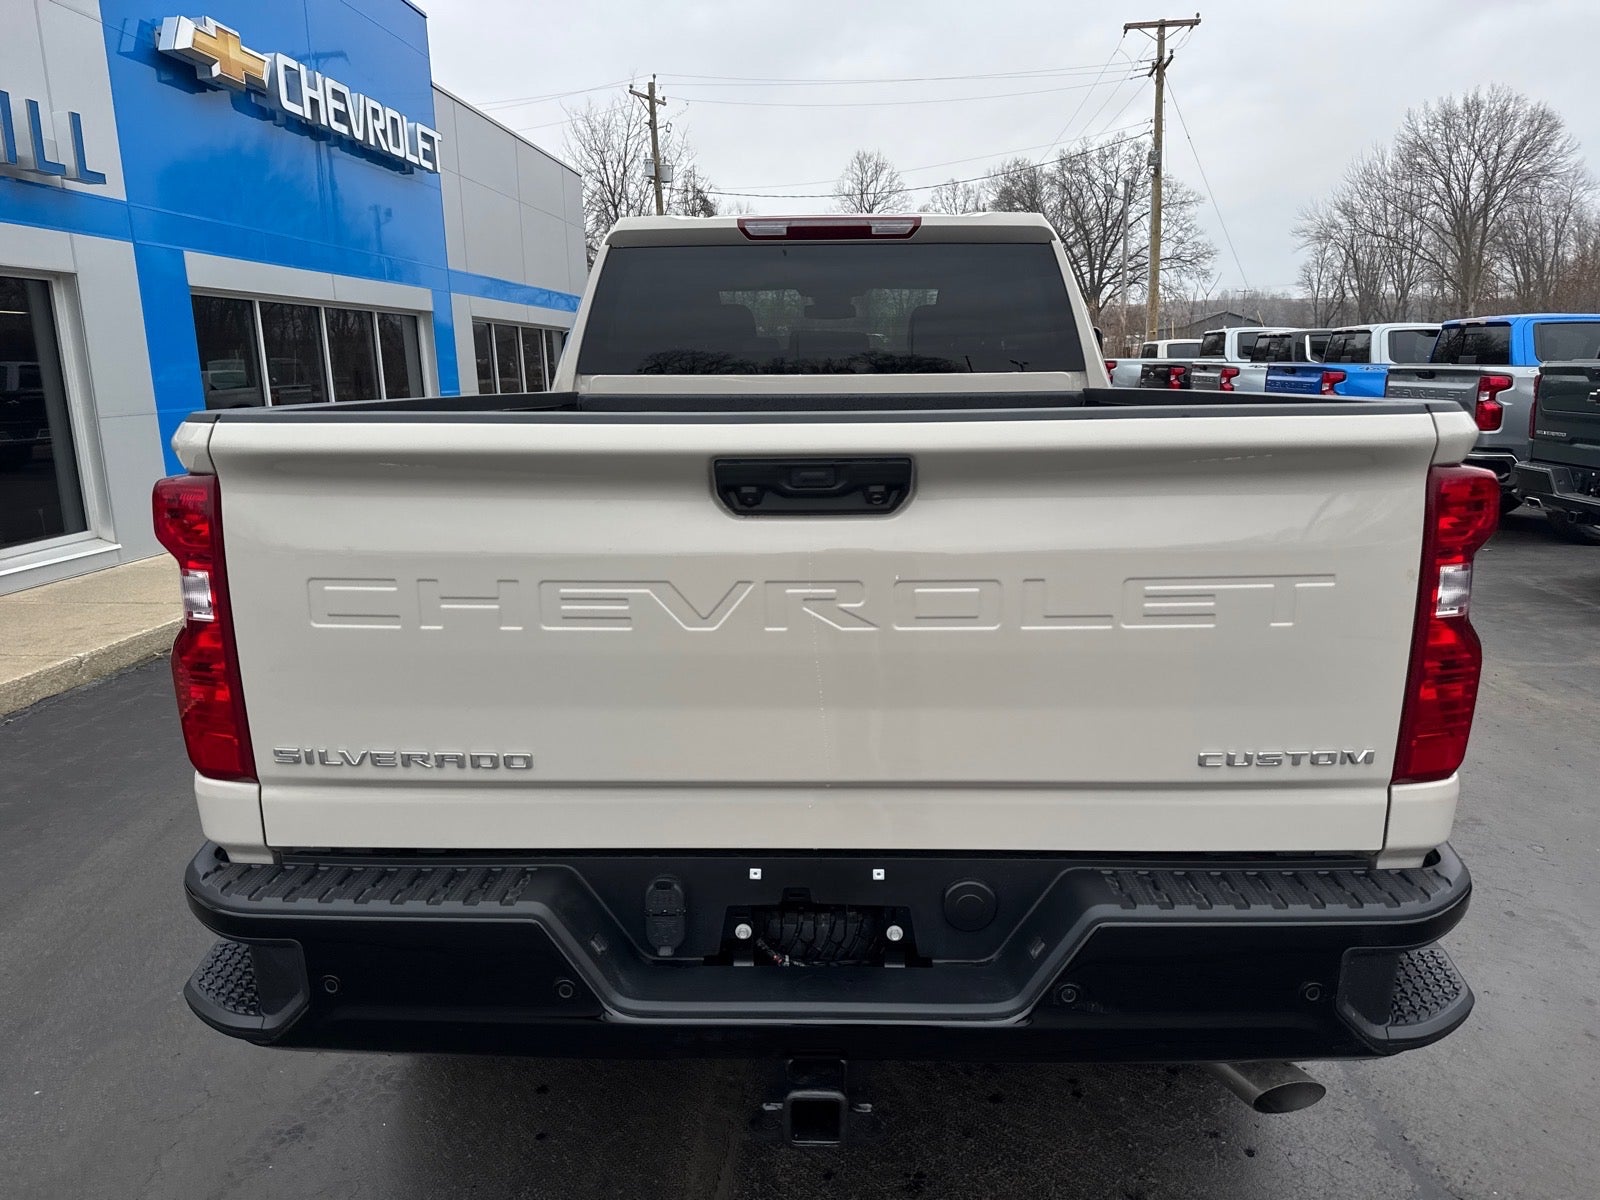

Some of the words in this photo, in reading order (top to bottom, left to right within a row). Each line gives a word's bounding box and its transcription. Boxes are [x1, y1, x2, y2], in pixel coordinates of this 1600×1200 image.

[275, 52, 442, 174] CHEVROLET
[307, 574, 1336, 633] CHEVROLET
[272, 747, 534, 770] SILVERADO
[1197, 748, 1376, 769] CUSTOM
